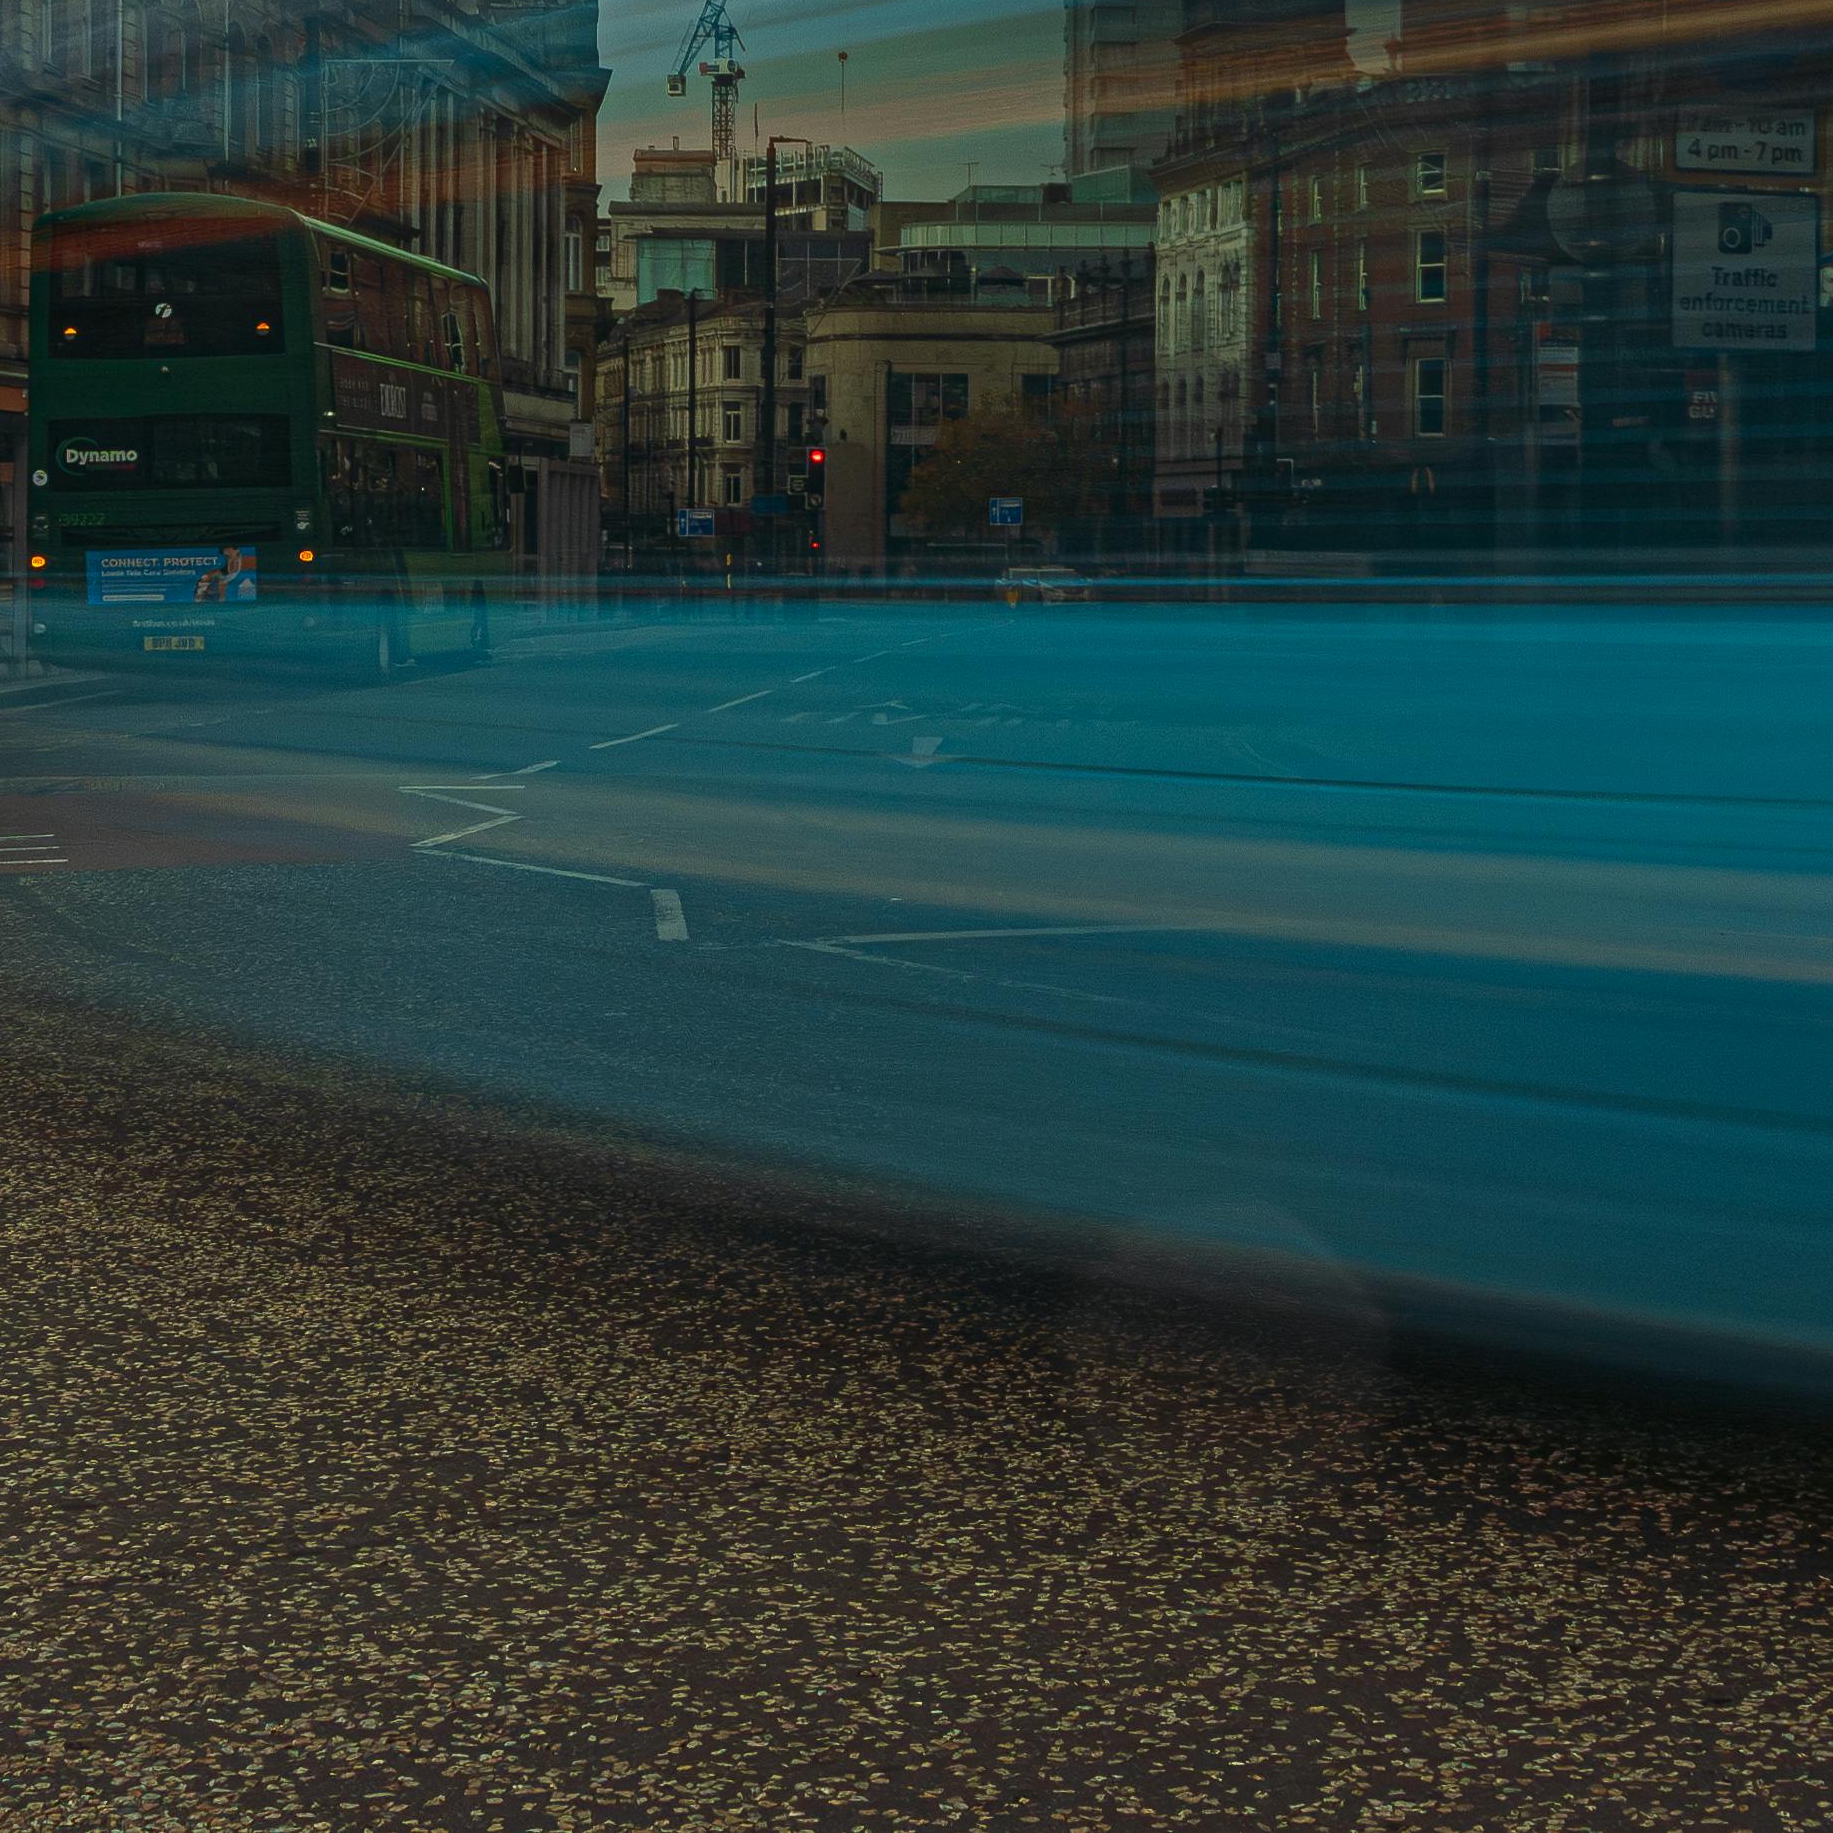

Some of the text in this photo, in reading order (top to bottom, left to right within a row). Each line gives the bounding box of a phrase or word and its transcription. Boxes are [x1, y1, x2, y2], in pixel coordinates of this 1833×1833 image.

[1776, 120, 1806, 136] am
[1688, 138, 1702, 157] 4
[1708, 144, 1738, 161] pm
[1755, 141, 1768, 159] 7
[1771, 146, 1803, 164] pm
[1711, 266, 1778, 288] Traffic
[1679, 292, 1810, 315] enforcement
[1701, 319, 1788, 339] cameras
[66, 449, 137, 465] Dynamo
